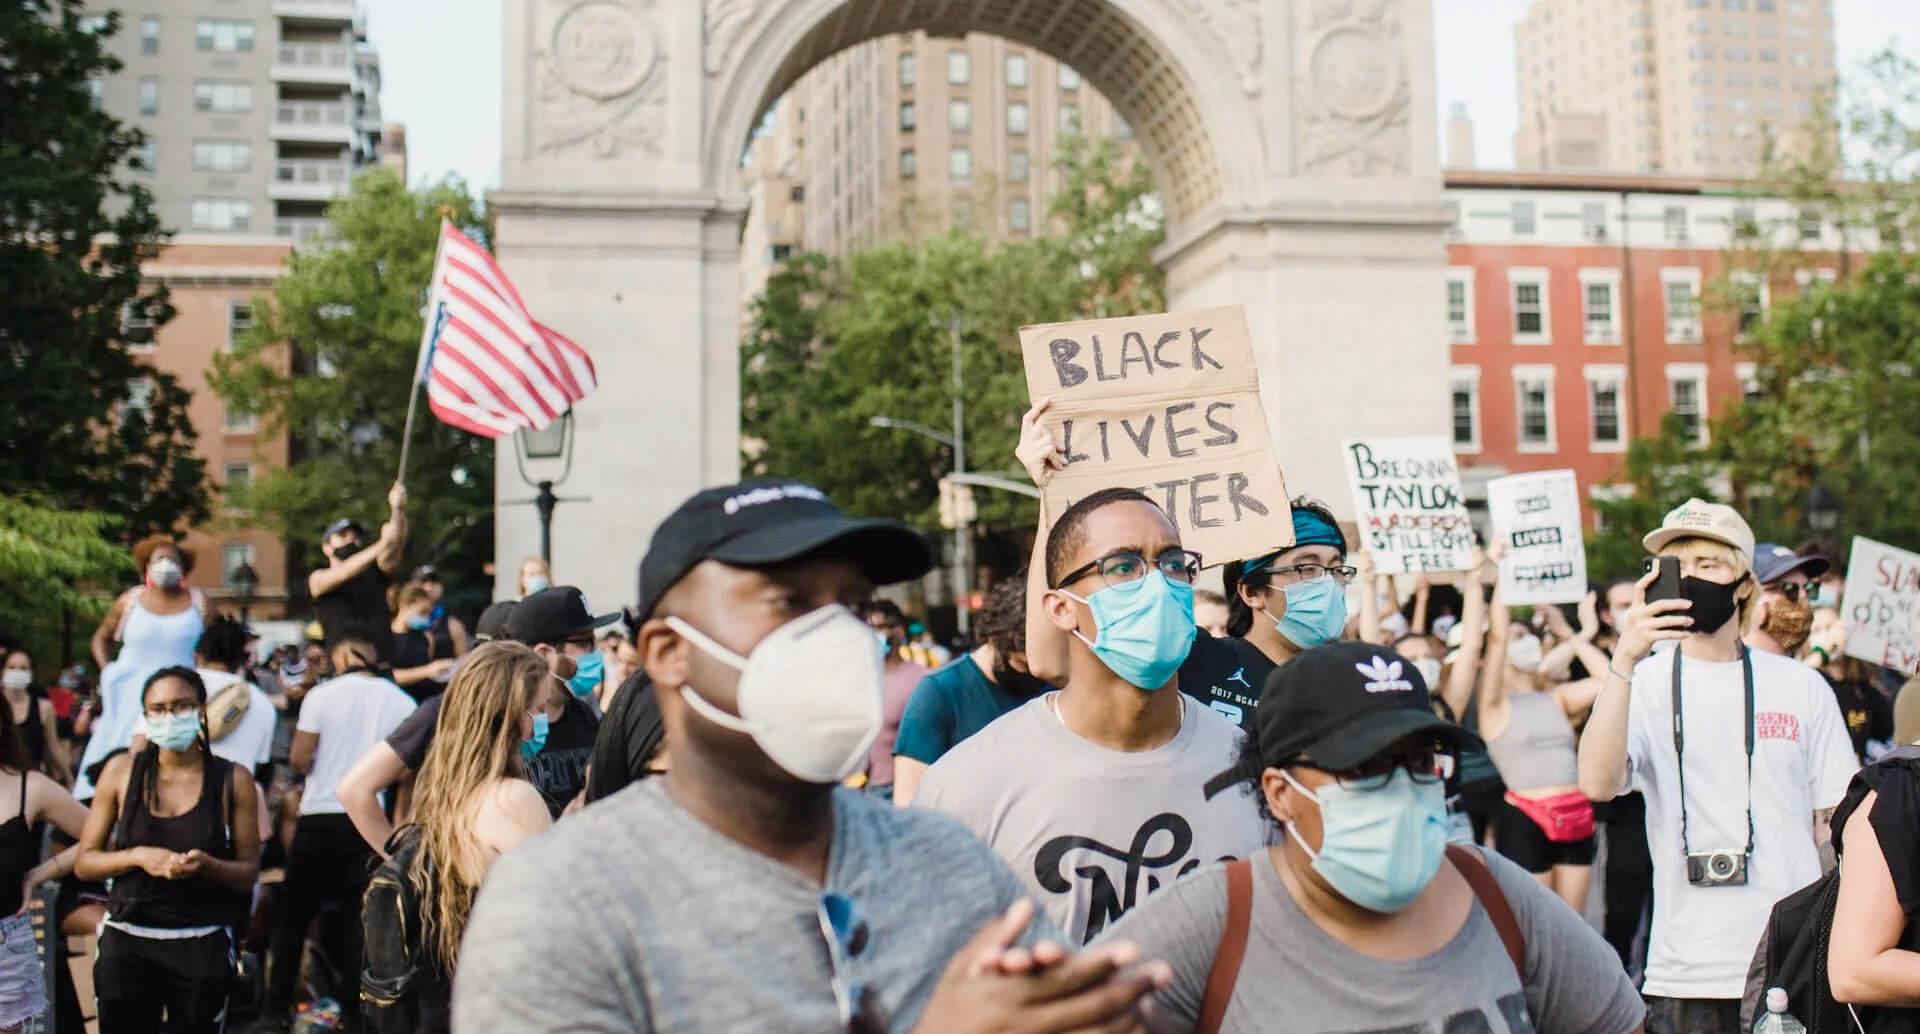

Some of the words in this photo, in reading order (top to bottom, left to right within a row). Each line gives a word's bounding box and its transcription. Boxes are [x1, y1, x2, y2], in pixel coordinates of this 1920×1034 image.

[1049, 327, 1223, 388] BLACK
[1062, 402, 1239, 464] LIVES
[1066, 472, 1269, 534] TER
[1360, 483, 1463, 510] TAYLOR
[1403, 553, 1454, 573] FREE
[1211, 686, 1232, 699] 2017
[1235, 694, 1260, 708] NCAA
